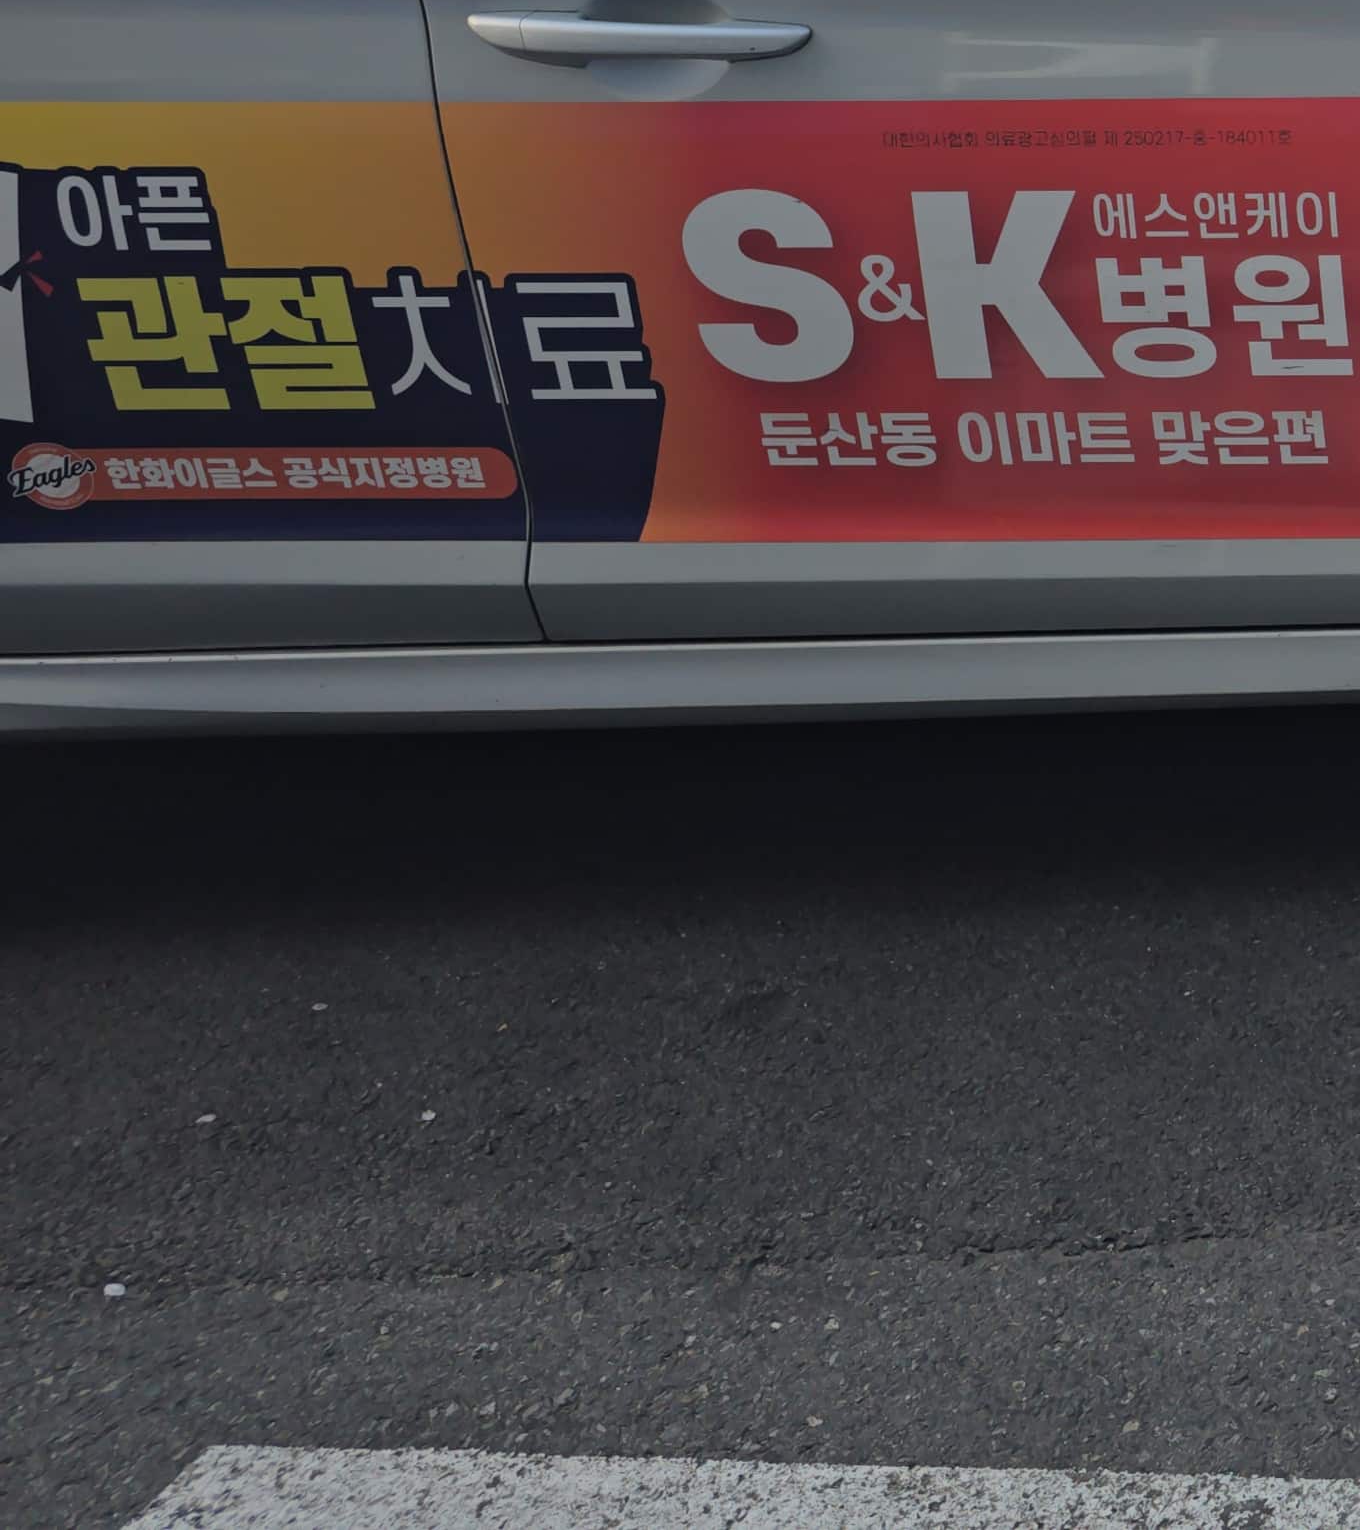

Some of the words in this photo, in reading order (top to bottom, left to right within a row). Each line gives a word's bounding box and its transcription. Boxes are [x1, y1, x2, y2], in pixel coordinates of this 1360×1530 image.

[1104, 130, 1118, 147] 제
[57, 173, 212, 252] 아픈
[1092, 190, 1340, 240] 에스앤케이
[681, 187, 1105, 383] S&K
[1095, 253, 1355, 378] 병원
[759, 411, 938, 469] 둔산동
[957, 410, 1136, 467] 이마트
[1153, 409, 1330, 468] 맞은편
[7, 454, 97, 498] Eagles
[104, 456, 279, 491] 한화이글스
[283, 455, 487, 490] 공식지정병원
